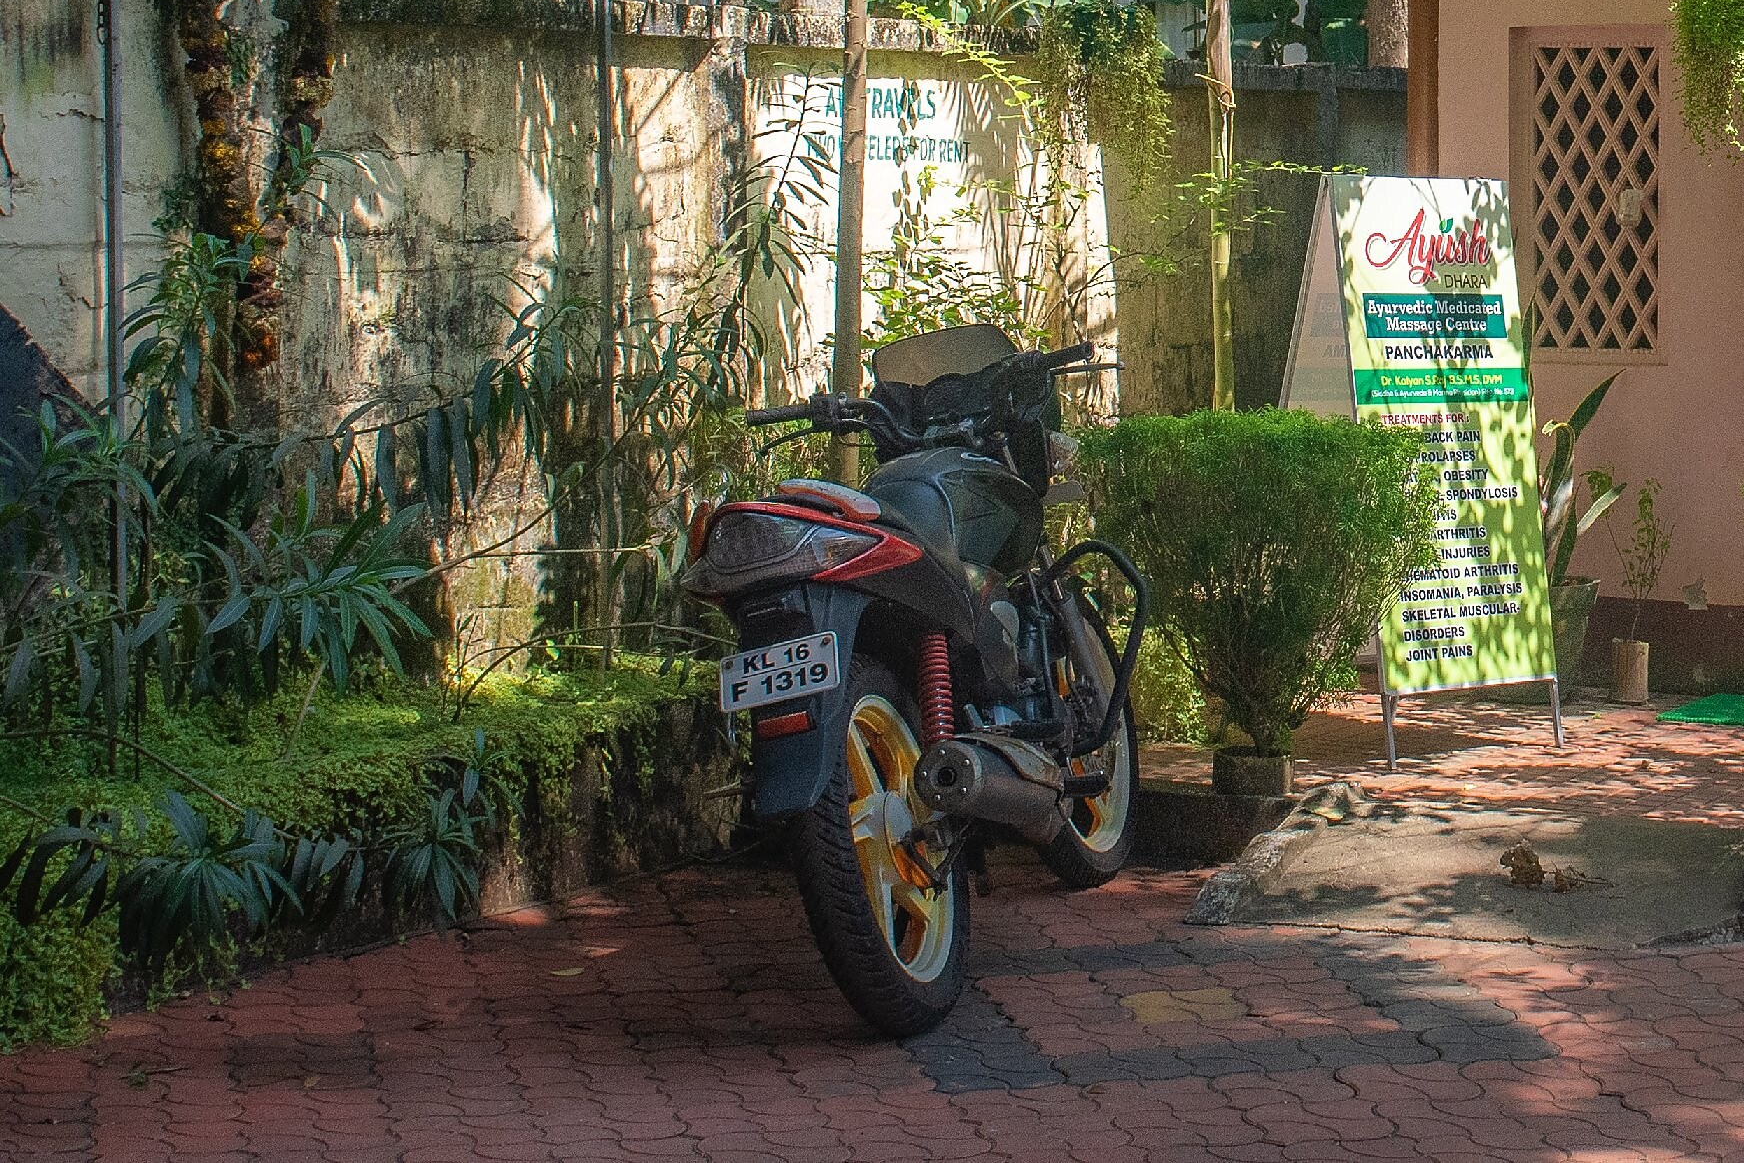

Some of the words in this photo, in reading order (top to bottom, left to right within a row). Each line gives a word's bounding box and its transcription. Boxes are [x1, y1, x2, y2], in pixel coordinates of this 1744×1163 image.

[939, 138, 971, 164] RENT
[1365, 207, 1494, 285] Ayush
[1444, 274, 1488, 289] DHARA
[1367, 300, 1433, 317] Ayurvedic
[1435, 300, 1501, 316] Medicated
[1386, 318, 1442, 335] Massage
[1445, 317, 1487, 331] Centre
[1385, 345, 1494, 360] PANCHAKARMA
[1395, 375, 1424, 388] Kalyan
[1482, 374, 1503, 385] DVM
[1381, 413, 1443, 424] TREATMENTS
[1424, 431, 1454, 443] BACK
[1457, 431, 1481, 442] PAIN
[1416, 450, 1476, 463] ROLAPSES
[1443, 469, 1489, 481] OBESITY
[1446, 486, 1518, 501] SPONDYLOSIS
[1441, 546, 1490, 559] INJURIES
[1464, 563, 1519, 577] ARTHRITIS
[1467, 583, 1522, 597] PARALYSIS
[1402, 608, 1456, 622] SKELETAL
[1459, 602, 1521, 617] MUSCULAR-
[1404, 626, 1465, 642] DISORDERS
[743, 652, 776, 675] KL
[783, 643, 811, 663] 16
[1406, 647, 1438, 662] JOINT
[1441, 645, 1473, 658] PAINS
[732, 681, 749, 703] F
[760, 662, 829, 695] 1319
